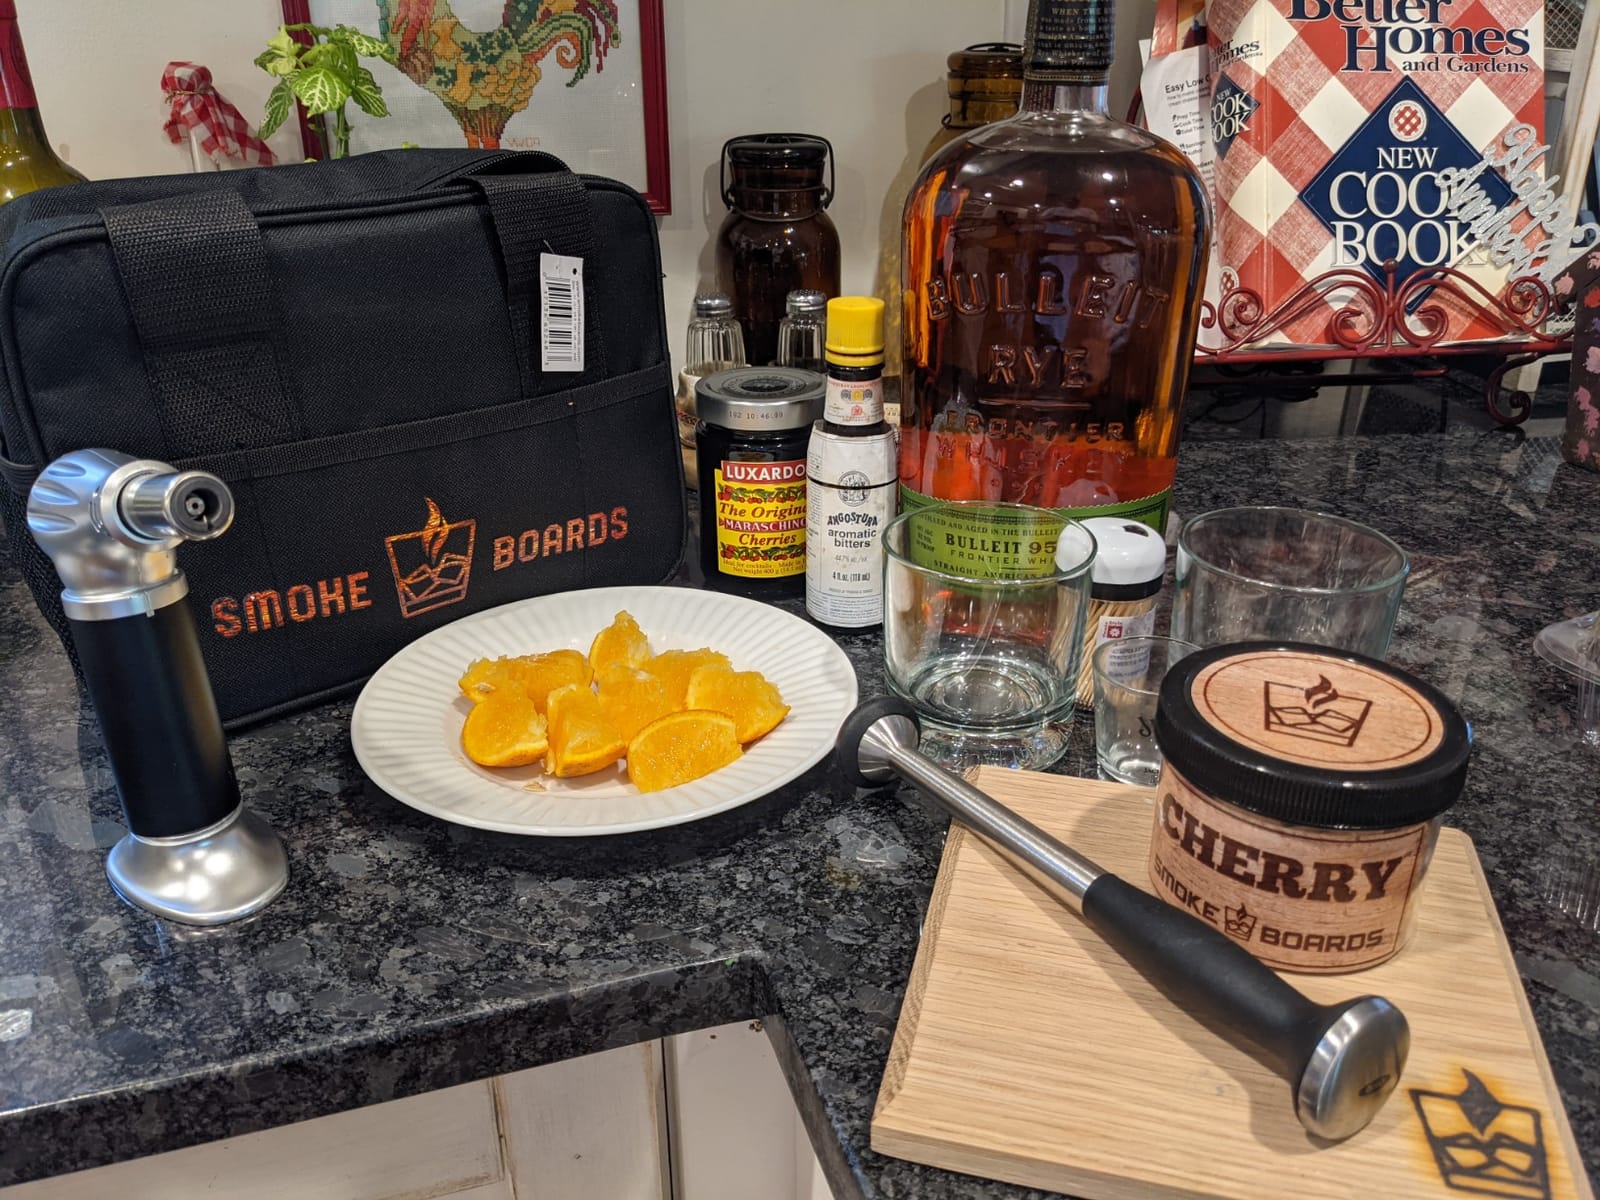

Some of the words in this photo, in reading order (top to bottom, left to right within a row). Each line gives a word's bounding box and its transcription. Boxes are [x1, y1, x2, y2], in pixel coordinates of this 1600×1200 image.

[1341, 25, 1530, 72] Homes
[1402, 57, 1440, 72] and
[1447, 56, 1529, 74] Gardens
[1165, 82, 1185, 94] Easy
[1186, 77, 1204, 89] Low
[1211, 92, 1252, 123] OOK
[1211, 111, 1251, 142] OOK
[1377, 147, 1439, 169] NEW
[1329, 171, 1466, 220] COO
[988, 343, 1088, 389] RYE
[726, 464, 806, 481] LUXARDO
[720, 502, 746, 517] The
[751, 503, 806, 520] Origin
[827, 512, 878, 526] ANGOSTURA
[828, 529, 877, 538] aromatic
[949, 521, 963, 531] AND
[965, 524, 988, 534] AGED
[1003, 528, 1019, 537] THE
[738, 533, 797, 546] Cherries
[834, 538, 871, 548] bitters
[945, 532, 1022, 555] BULLEIT
[1029, 541, 1057, 554] 95
[951, 549, 1020, 565] FRONTIER
[211, 571, 373, 638] SMOKE
[493, 506, 628, 571] BOARDS
[934, 559, 978, 576] STRAIGHT
[1159, 793, 1403, 902] CHERRY
[1155, 854, 1221, 927] SMOKE
[1260, 927, 1385, 954] BOARDS
